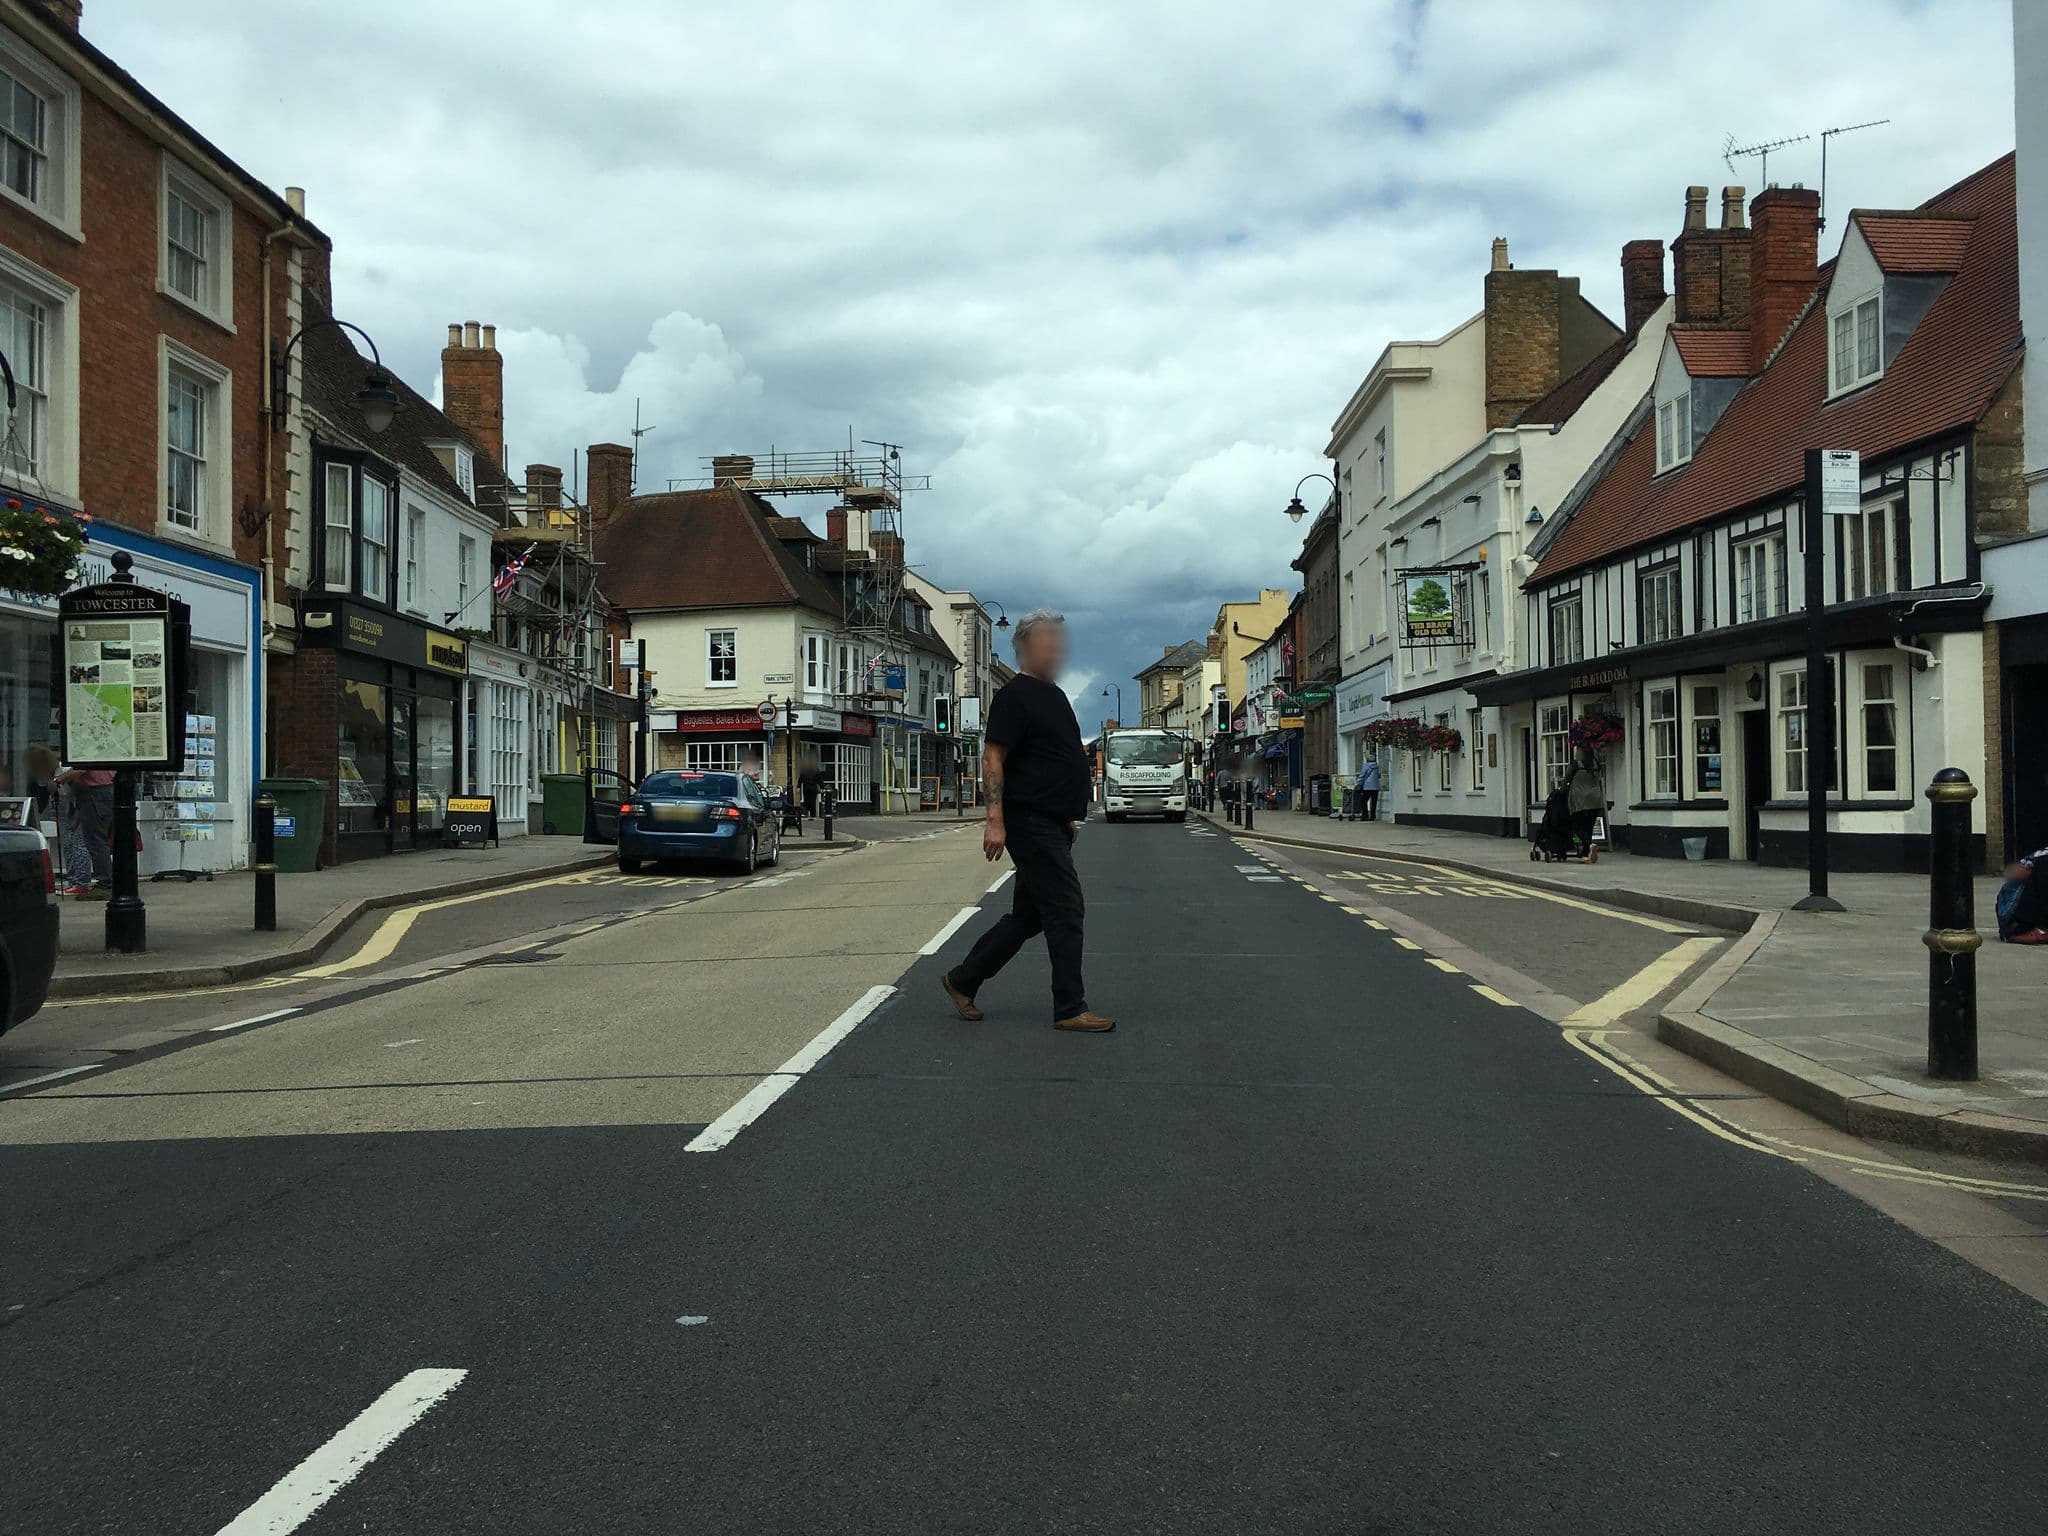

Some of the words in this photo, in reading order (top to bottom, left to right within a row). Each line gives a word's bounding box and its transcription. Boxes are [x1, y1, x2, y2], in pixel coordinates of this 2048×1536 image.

[73, 598, 156, 611] TOWCESTER
[1426, 621, 1452, 629] BRAVE
[1414, 628, 1430, 636] OLD
[431, 643, 466, 670] mustard
[1571, 676, 1582, 689] THE
[1600, 670, 1613, 684] OLD
[1614, 666, 1630, 681] OAK
[735, 714, 741, 724] &
[449, 802, 489, 810] mustard
[450, 824, 482, 836] open
